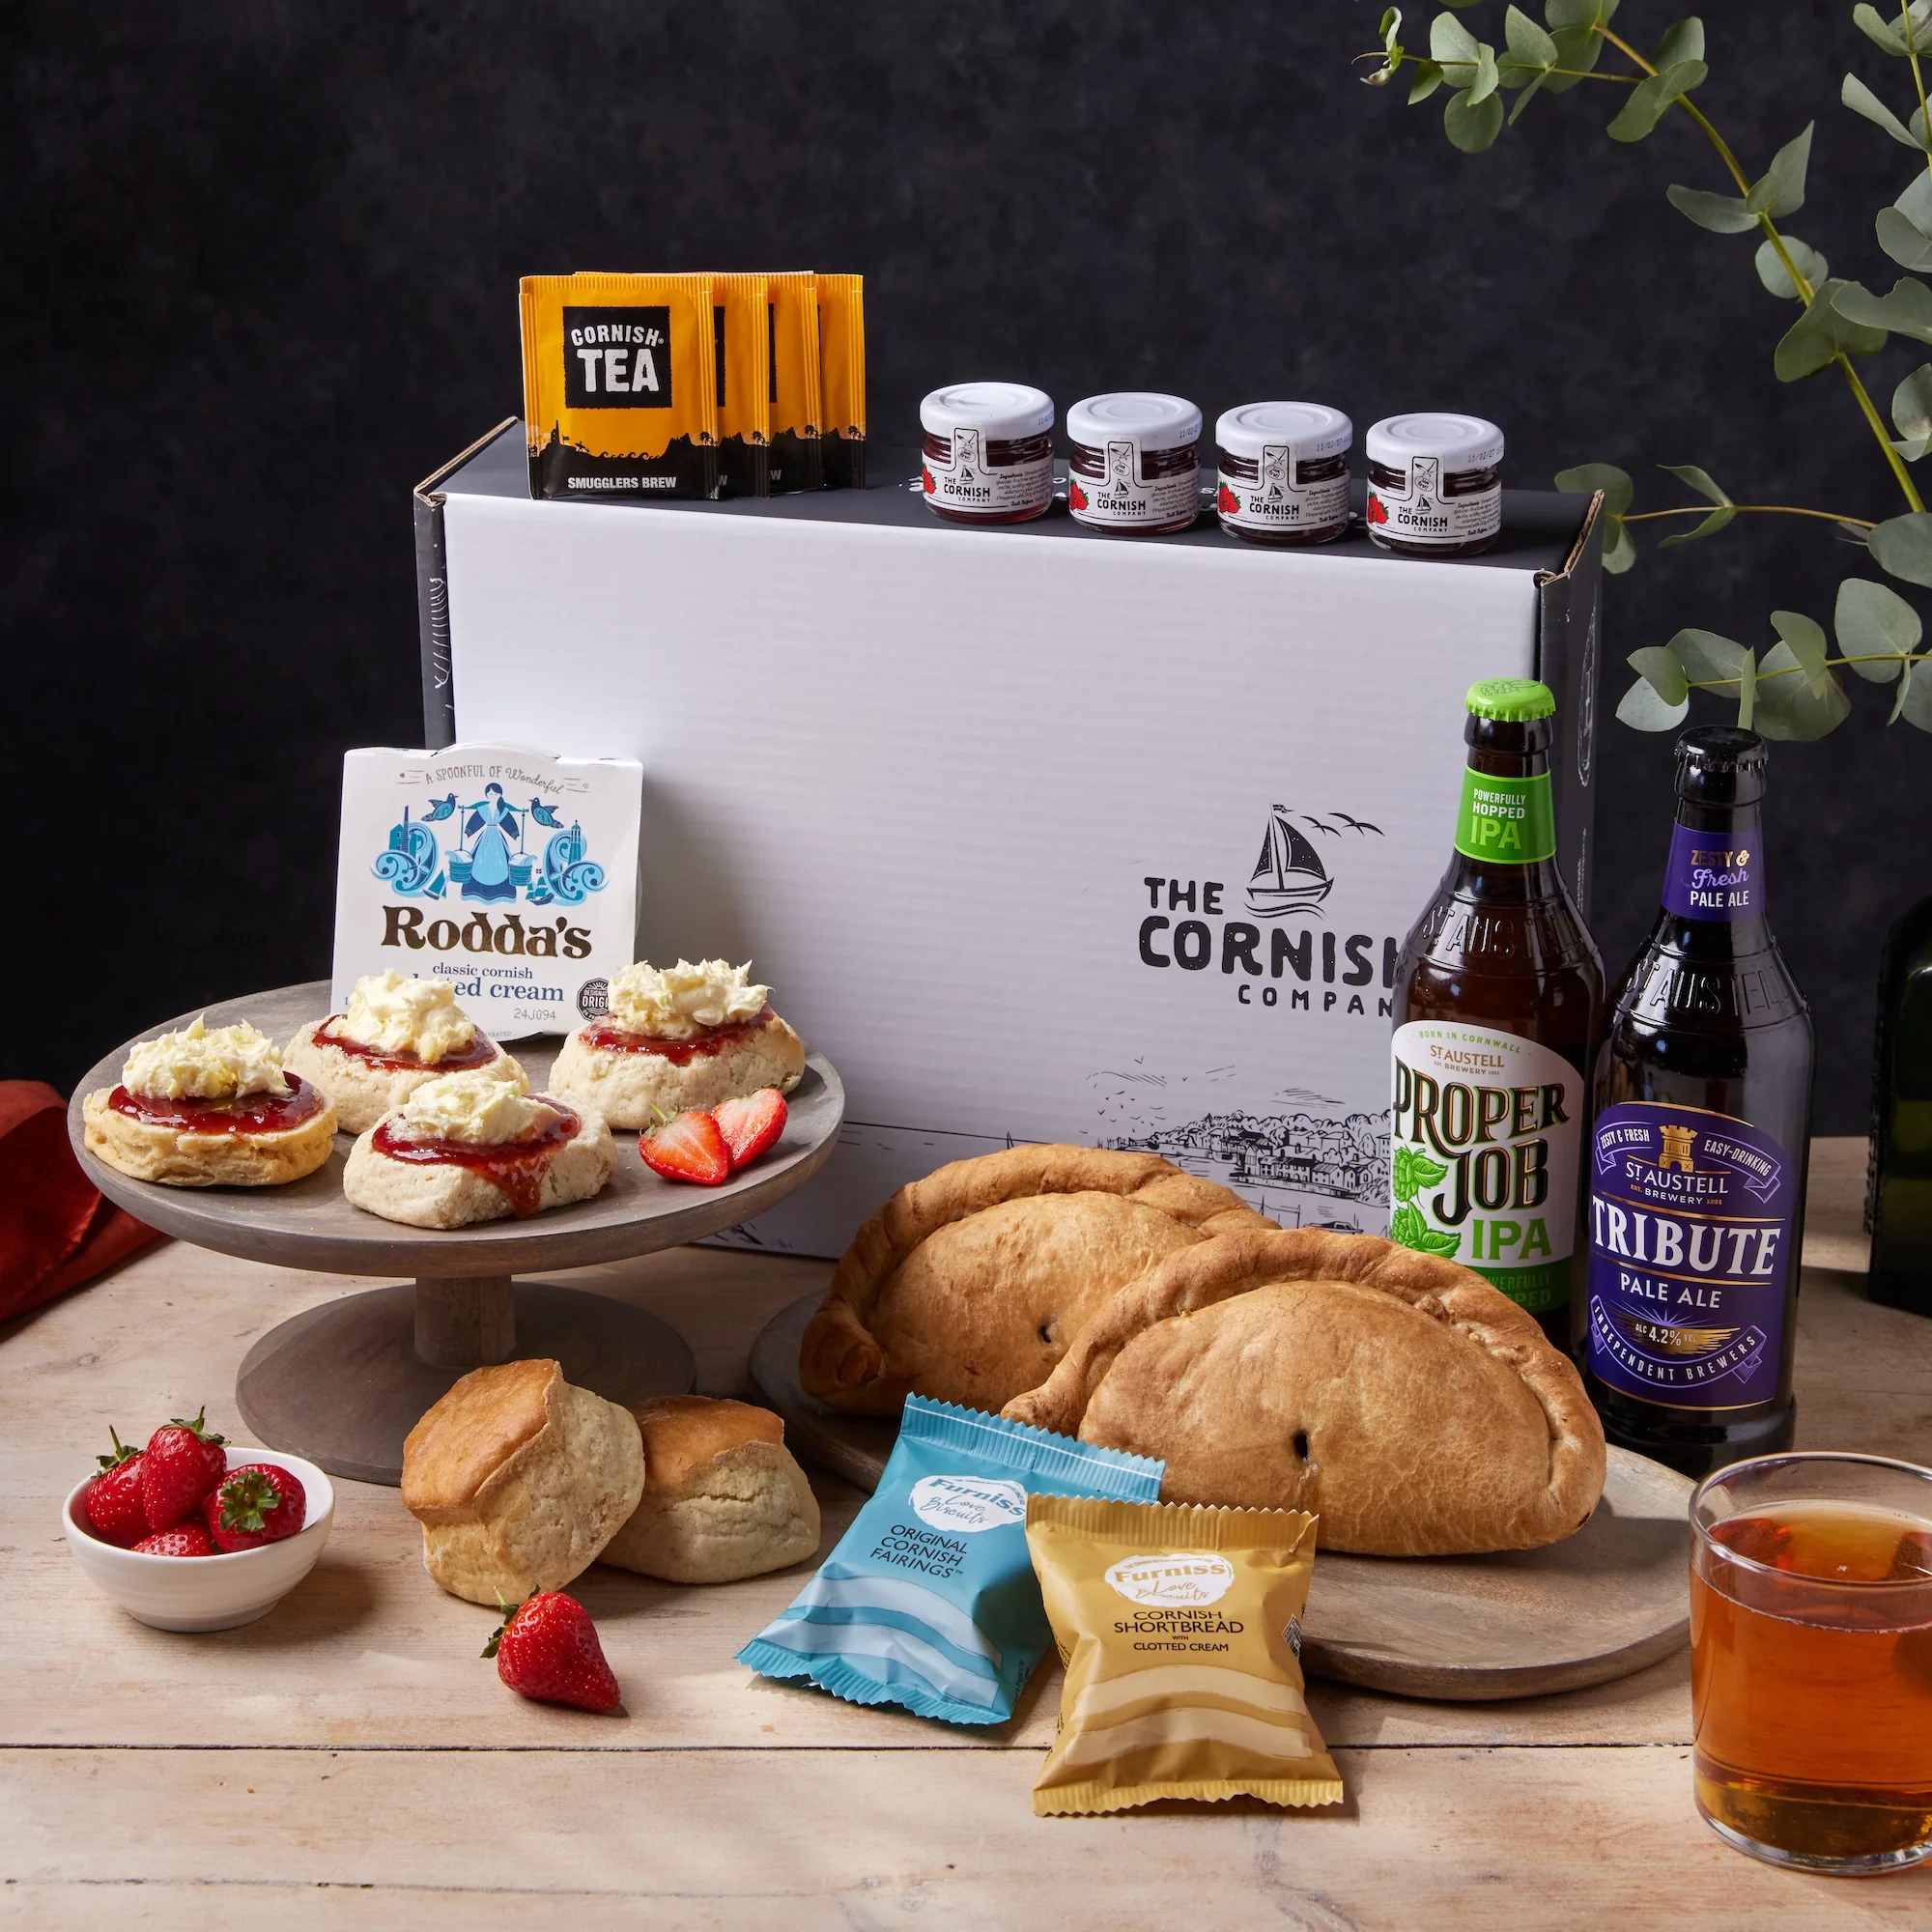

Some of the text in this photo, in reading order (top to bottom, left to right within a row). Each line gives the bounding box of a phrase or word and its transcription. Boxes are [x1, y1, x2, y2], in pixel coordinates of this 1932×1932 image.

[577, 349, 660, 393] TEA
[567, 476, 677, 490] SMUGGLERS BREW
[944, 484, 990, 497] CORNISH
[945, 476, 956, 485] THE
[1097, 499, 1147, 511] CORNISH
[1249, 502, 1300, 515] CORNISH
[1398, 514, 1448, 527] CORNISH
[425, 765, 564, 794] A SPOONFUL OF Wonderful
[1473, 788, 1526, 806] POWERFULLY
[1473, 802, 1525, 819] HOPPED
[1470, 815, 1521, 849] IPA
[1690, 849, 1750, 867] ZESTY &
[1691, 867, 1749, 889] Fresh
[1144, 876, 1224, 915] THE
[1690, 890, 1749, 907] PALE ALE
[381, 905, 592, 959] Rodda's
[433, 962, 533, 979] classic cornish
[490, 983, 565, 1002] cream
[582, 995, 608, 1008] ORIGI
[1237, 984, 1393, 1016] COMPAN
[1419, 1030, 1442, 1038] BORN
[1463, 1034, 1521, 1054] CORNWALL
[1443, 1051, 1505, 1068] AUSTELL
[1444, 1063, 1487, 1075] BREWERY
[1393, 1056, 1570, 1158] PROPER
[1600, 1130, 1616, 1150] ZESTY
[1625, 1128, 1650, 1143] FRESH
[1704, 1139, 1773, 1178] EASY-DRINKING
[1433, 1138, 1549, 1226] JOB
[1644, 1171, 1728, 1194] AUSTELL
[1644, 1188, 1703, 1205] BREWERY
[1471, 1217, 1553, 1261] IPA
[1592, 1194, 1781, 1276] TRIBUTE
[1620, 1272, 1722, 1309] PALE ALE
[1594, 1306, 1756, 1381] INDEPENDENT BREWERS
[1634, 1322, 1697, 1347] ALC 4.2% VOL
[928, 1478, 1026, 1516] Furniss
[945, 1494, 986, 1511] Love
[920, 1496, 989, 1524] Biscuits
[891, 1524, 967, 1554] ORIGINAL
[881, 1537, 964, 1567] CORNISH
[1114, 1564, 1226, 1582] Furniss
[1152, 1580, 1196, 1596] Love
[1133, 1610, 1222, 1620] CORNISH
[1114, 1621, 1244, 1634] SHORTBREAD
[1133, 1643, 1229, 1652] CLOTTED CREAM
